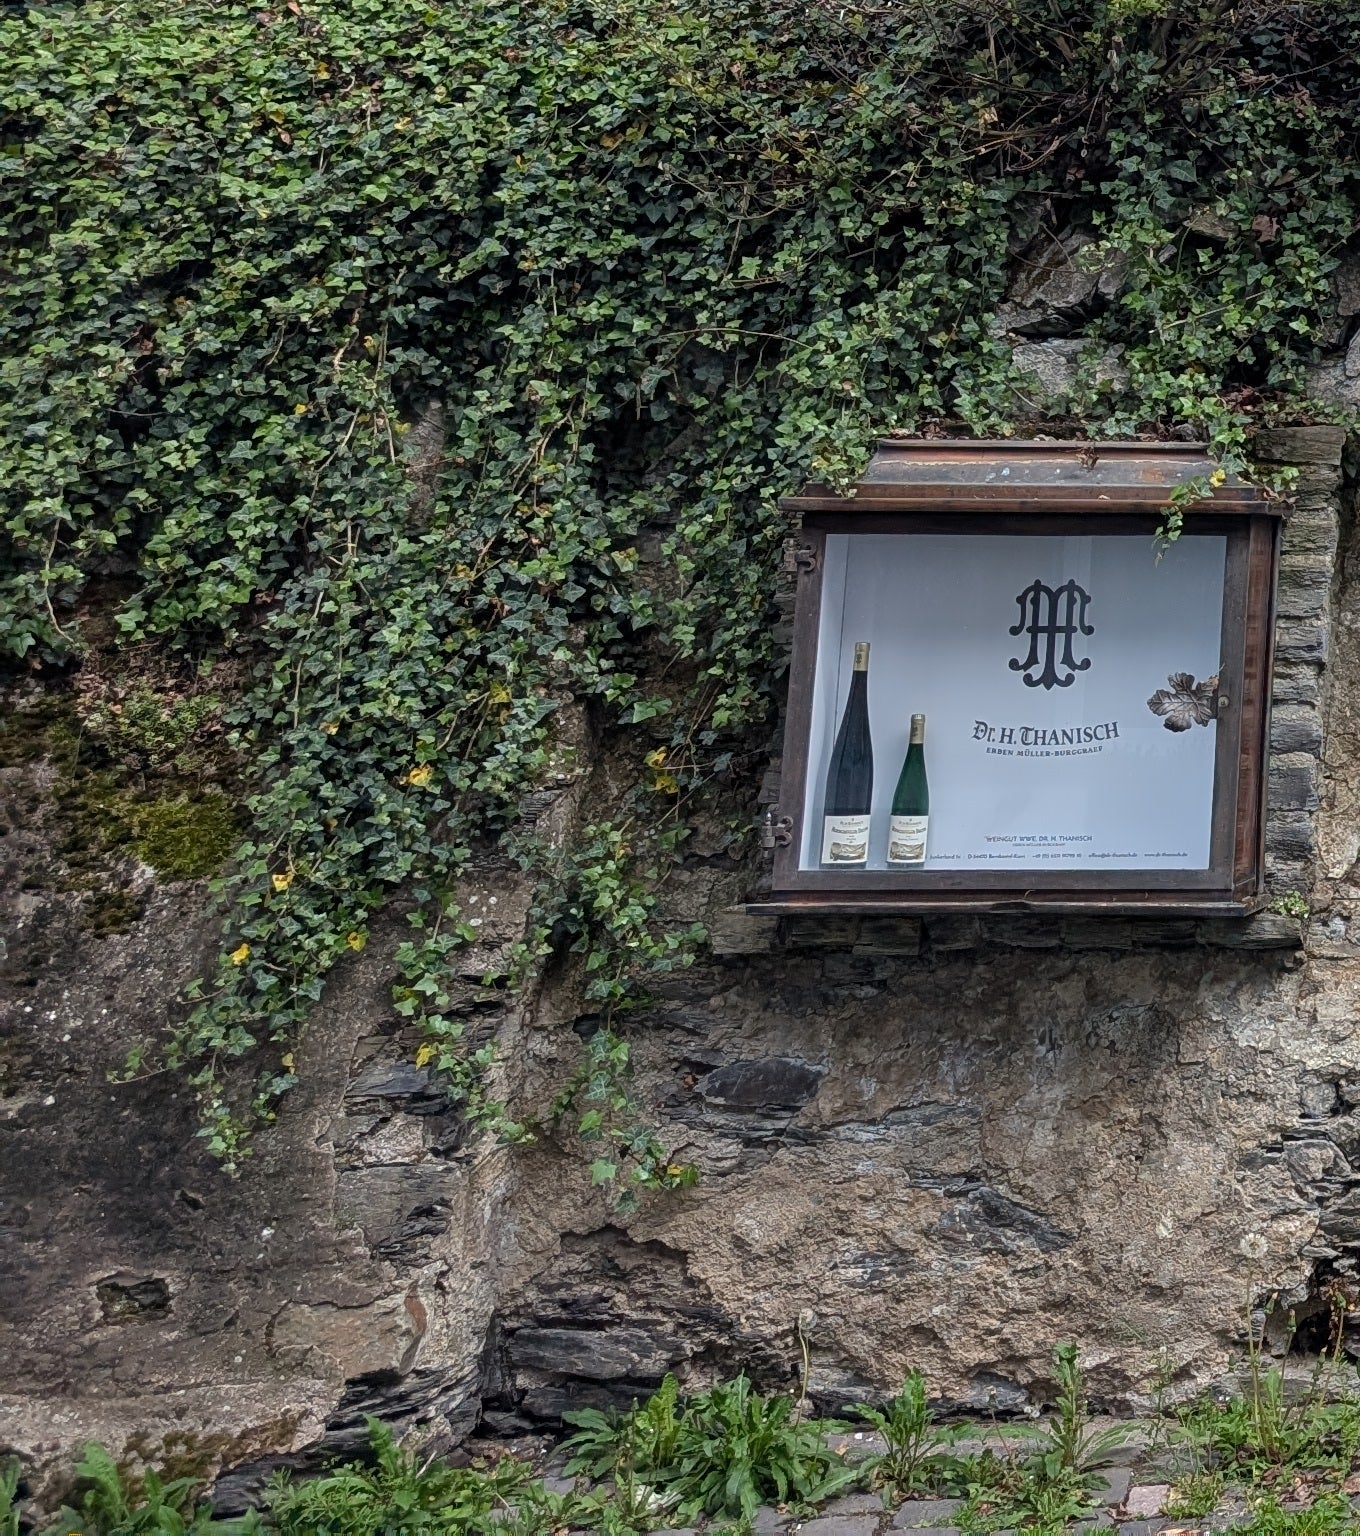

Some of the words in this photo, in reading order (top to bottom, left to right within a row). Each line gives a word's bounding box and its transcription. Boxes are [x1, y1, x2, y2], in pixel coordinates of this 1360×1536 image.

[971, 719, 996, 742] Dr.
[1000, 726, 1017, 745] H.
[1019, 721, 1121, 746] THANISCH
[985, 746, 1014, 757] ERBEN
